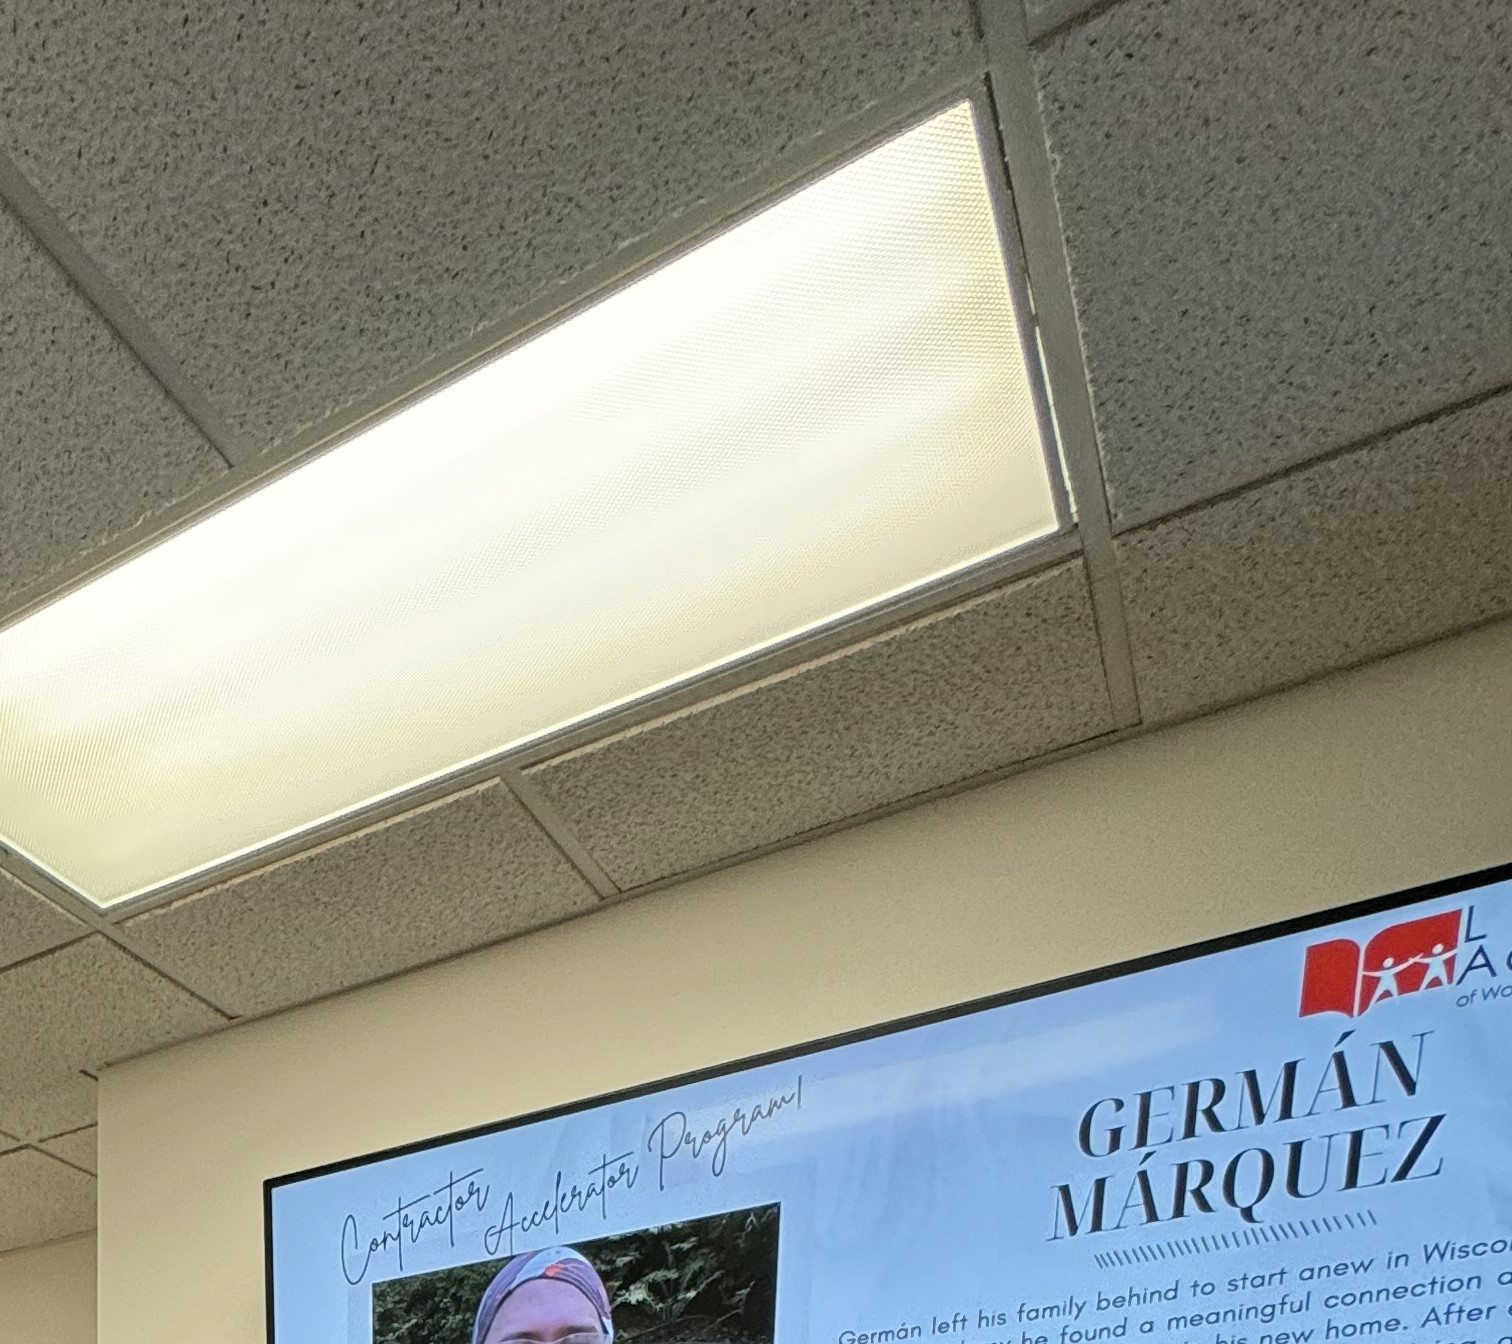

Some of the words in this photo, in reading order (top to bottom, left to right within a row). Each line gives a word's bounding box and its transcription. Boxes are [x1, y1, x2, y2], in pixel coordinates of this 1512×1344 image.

[1076, 1028, 1435, 1159] GERMÁN
[341, 1168, 489, 1285] Contractor
[484, 1152, 639, 1255] Accelerator
[1045, 1112, 1447, 1242] MÁRQUEZ
[931, 1311, 969, 1336] left
[977, 1308, 1007, 1330] his
[1016, 1294, 1088, 1324] family
[1095, 1278, 1180, 1312] behind
[1226, 1267, 1289, 1293] start
[1298, 1257, 1375, 1282] anew
[1166, 1289, 1312, 1332] meaningful
[1323, 1275, 1483, 1310] connection
[1324, 1317, 1409, 1341] home.
[1420, 1302, 1498, 1329] After
